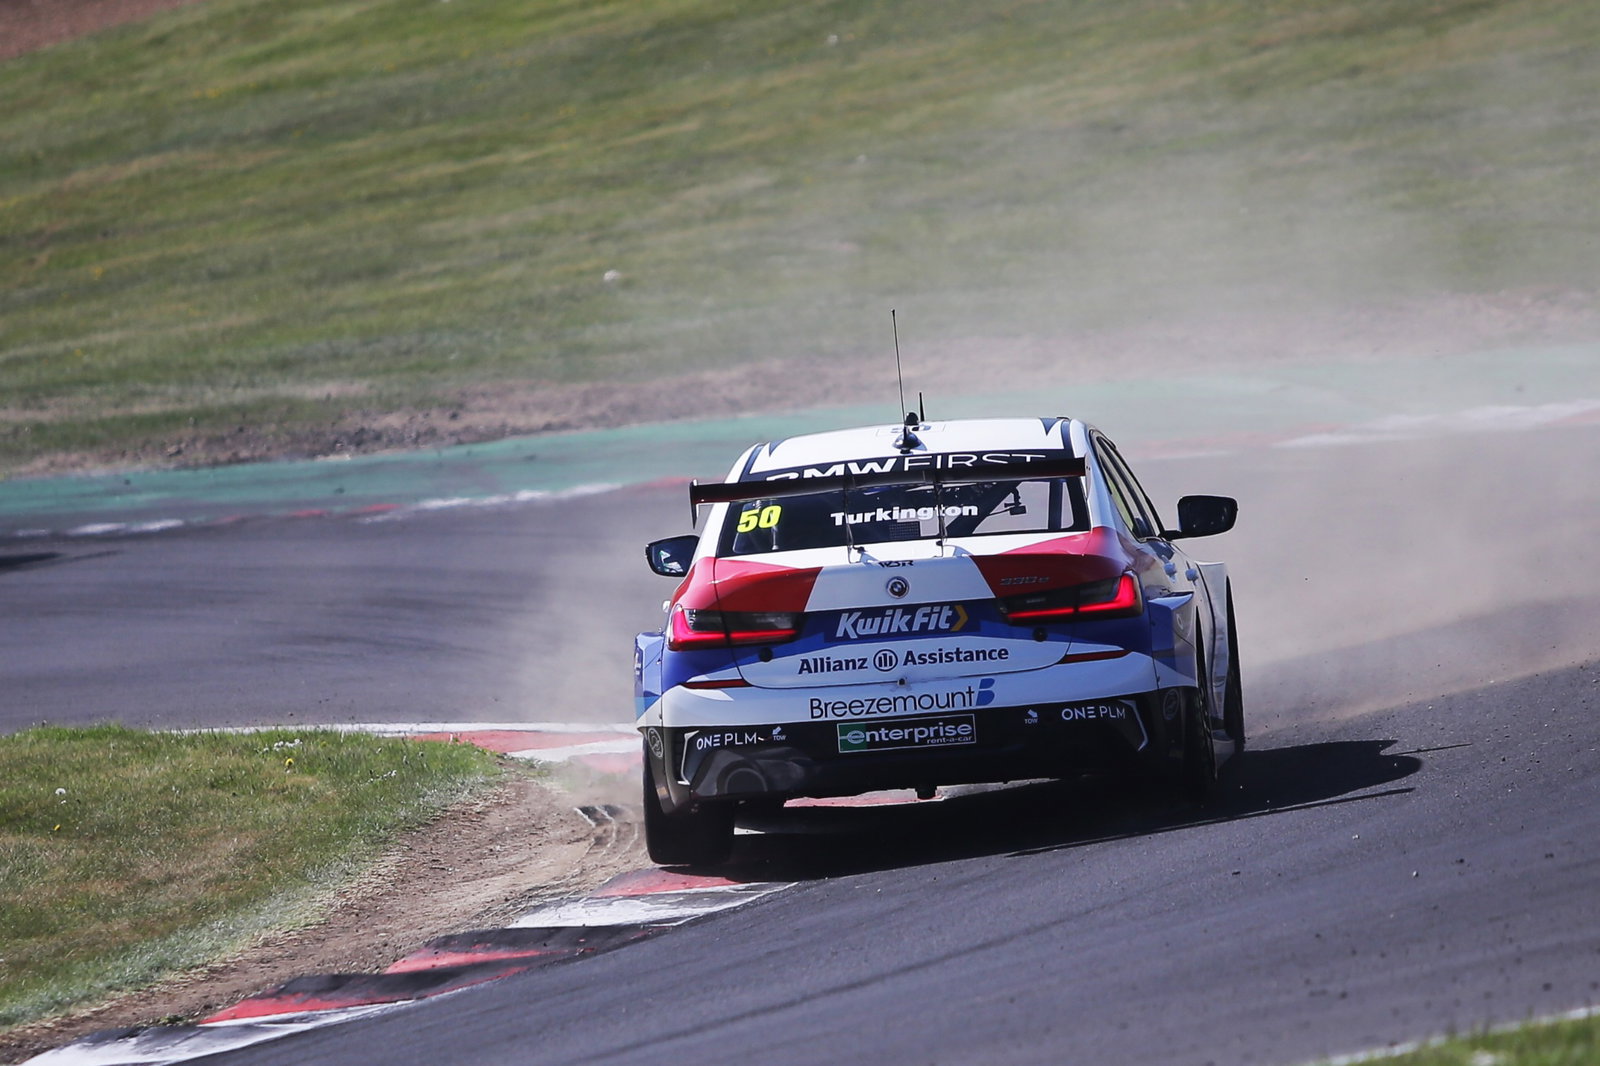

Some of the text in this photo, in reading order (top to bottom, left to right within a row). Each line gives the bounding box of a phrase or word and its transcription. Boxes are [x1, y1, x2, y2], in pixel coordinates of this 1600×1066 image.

[766, 458, 897, 481] MW
[737, 505, 782, 533] 50
[830, 503, 979, 526] Turkington
[798, 647, 1009, 675] Allianz Assistance
[810, 685, 975, 719] Breezemount
[1061, 705, 1126, 721] ONE PLM
[846, 721, 973, 744] enterprise
[1024, 717, 1038, 725] TOW
[696, 732, 757, 750] ONE PLM
[773, 734, 787, 742] TOW
[926, 734, 973, 745] rent-a-car
